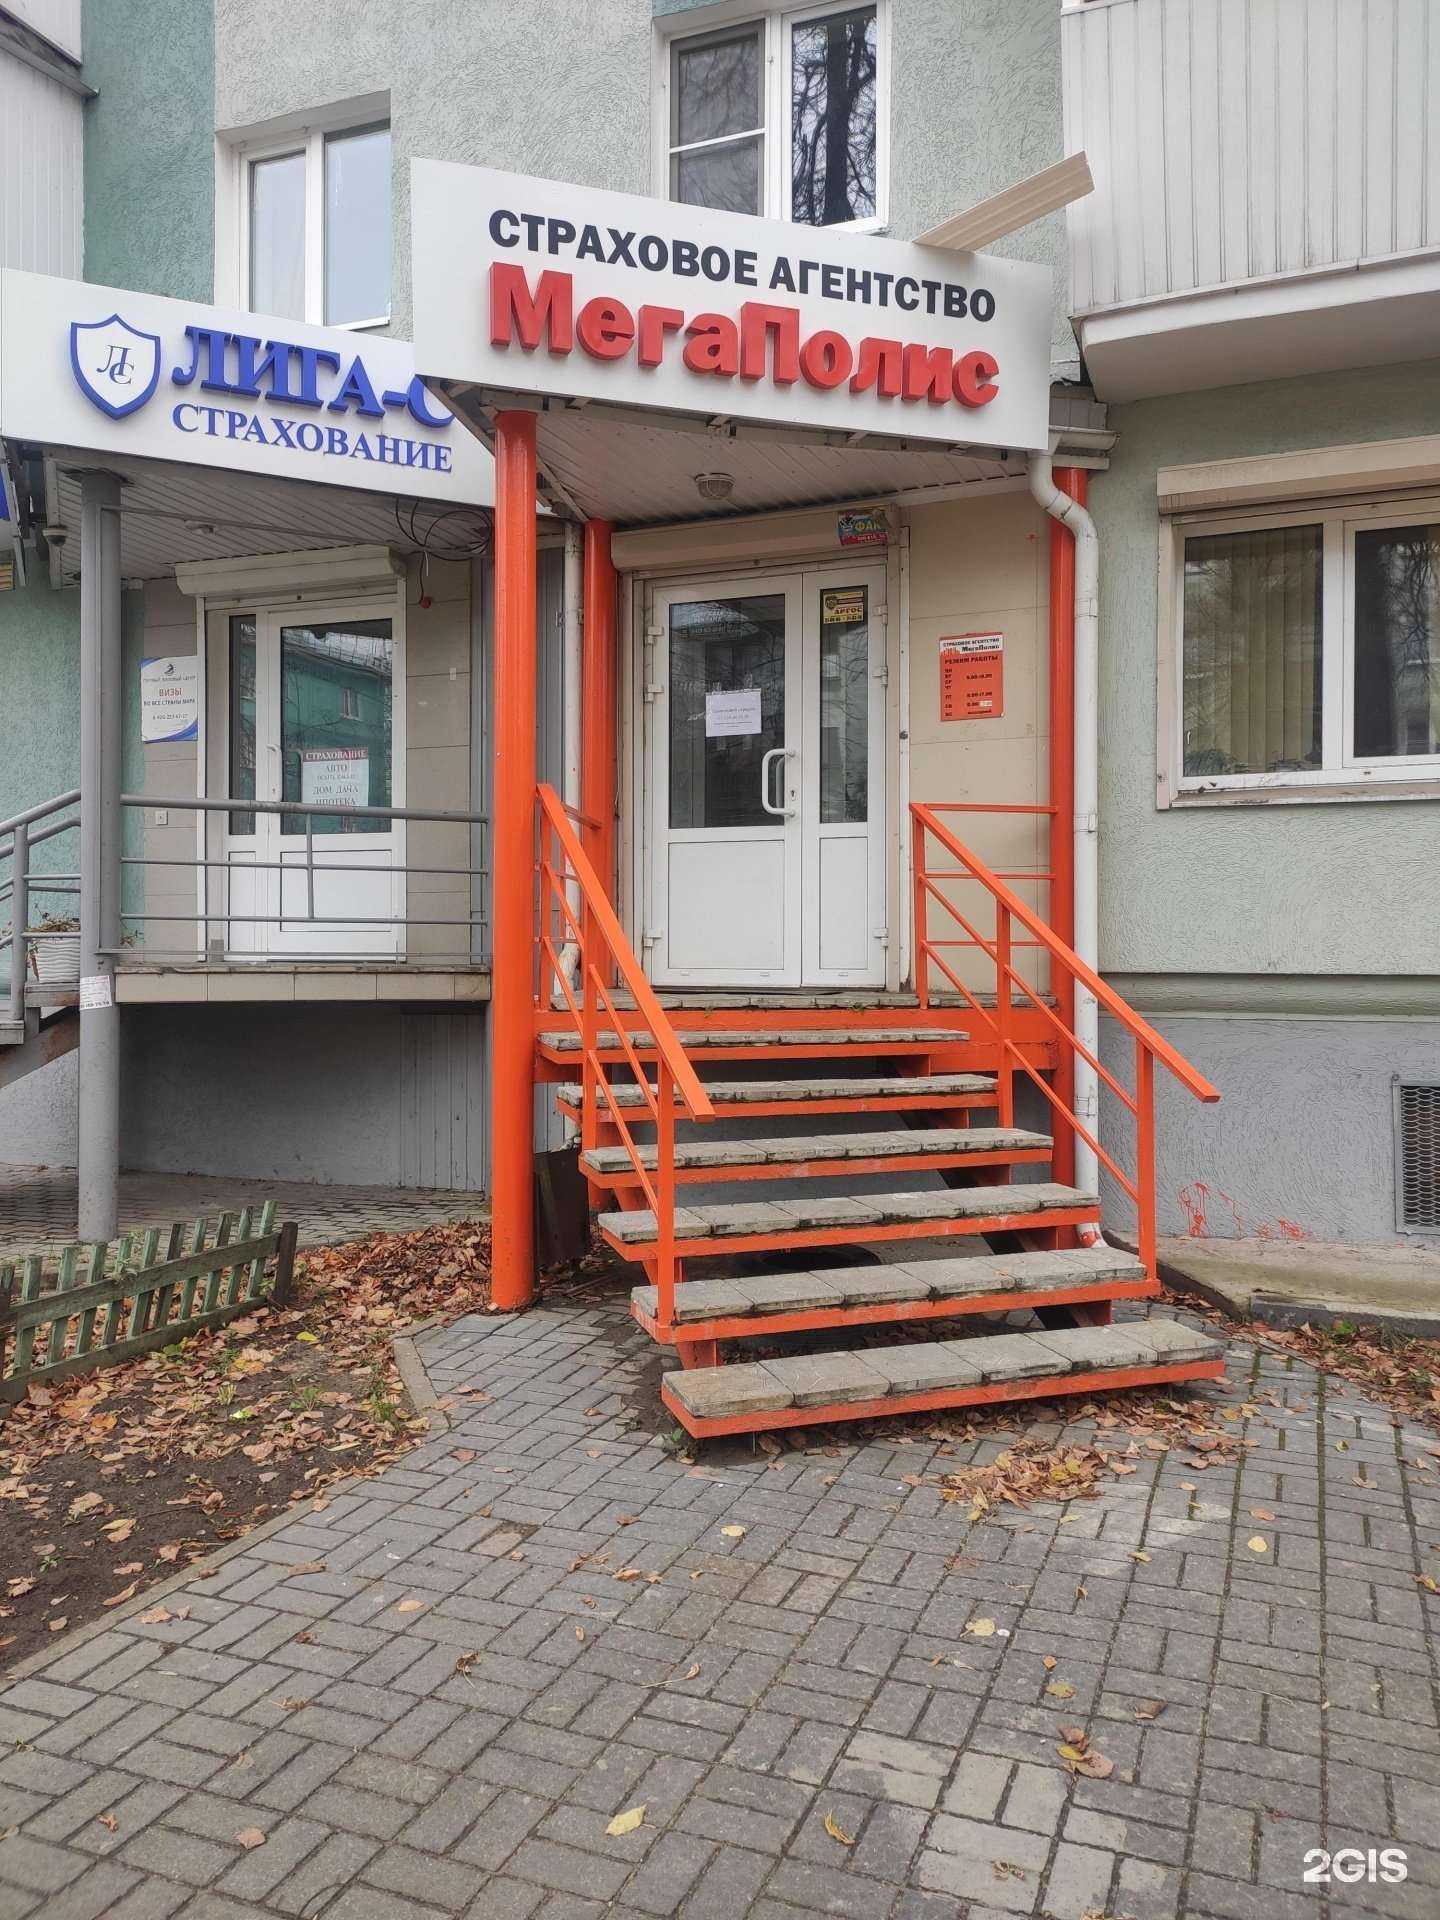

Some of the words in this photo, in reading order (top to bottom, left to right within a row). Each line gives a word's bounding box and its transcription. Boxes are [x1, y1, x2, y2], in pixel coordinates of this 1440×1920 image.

[489, 210, 757, 287] СТРАХОВОЕ
[768, 257, 996, 322] АГЕНТСТВО
[489, 262, 1000, 409] МегаПолис
[172, 403, 452, 473] СТРАХОВАНИЕ
[159, 688, 182, 697] ВИЗЫ
[305, 750, 367, 760] СТРАХОВАНИЕ
[326, 764, 348, 772] АВТО
[313, 786, 332, 794] ДОМ
[336, 784, 358, 793] ДАЧА
